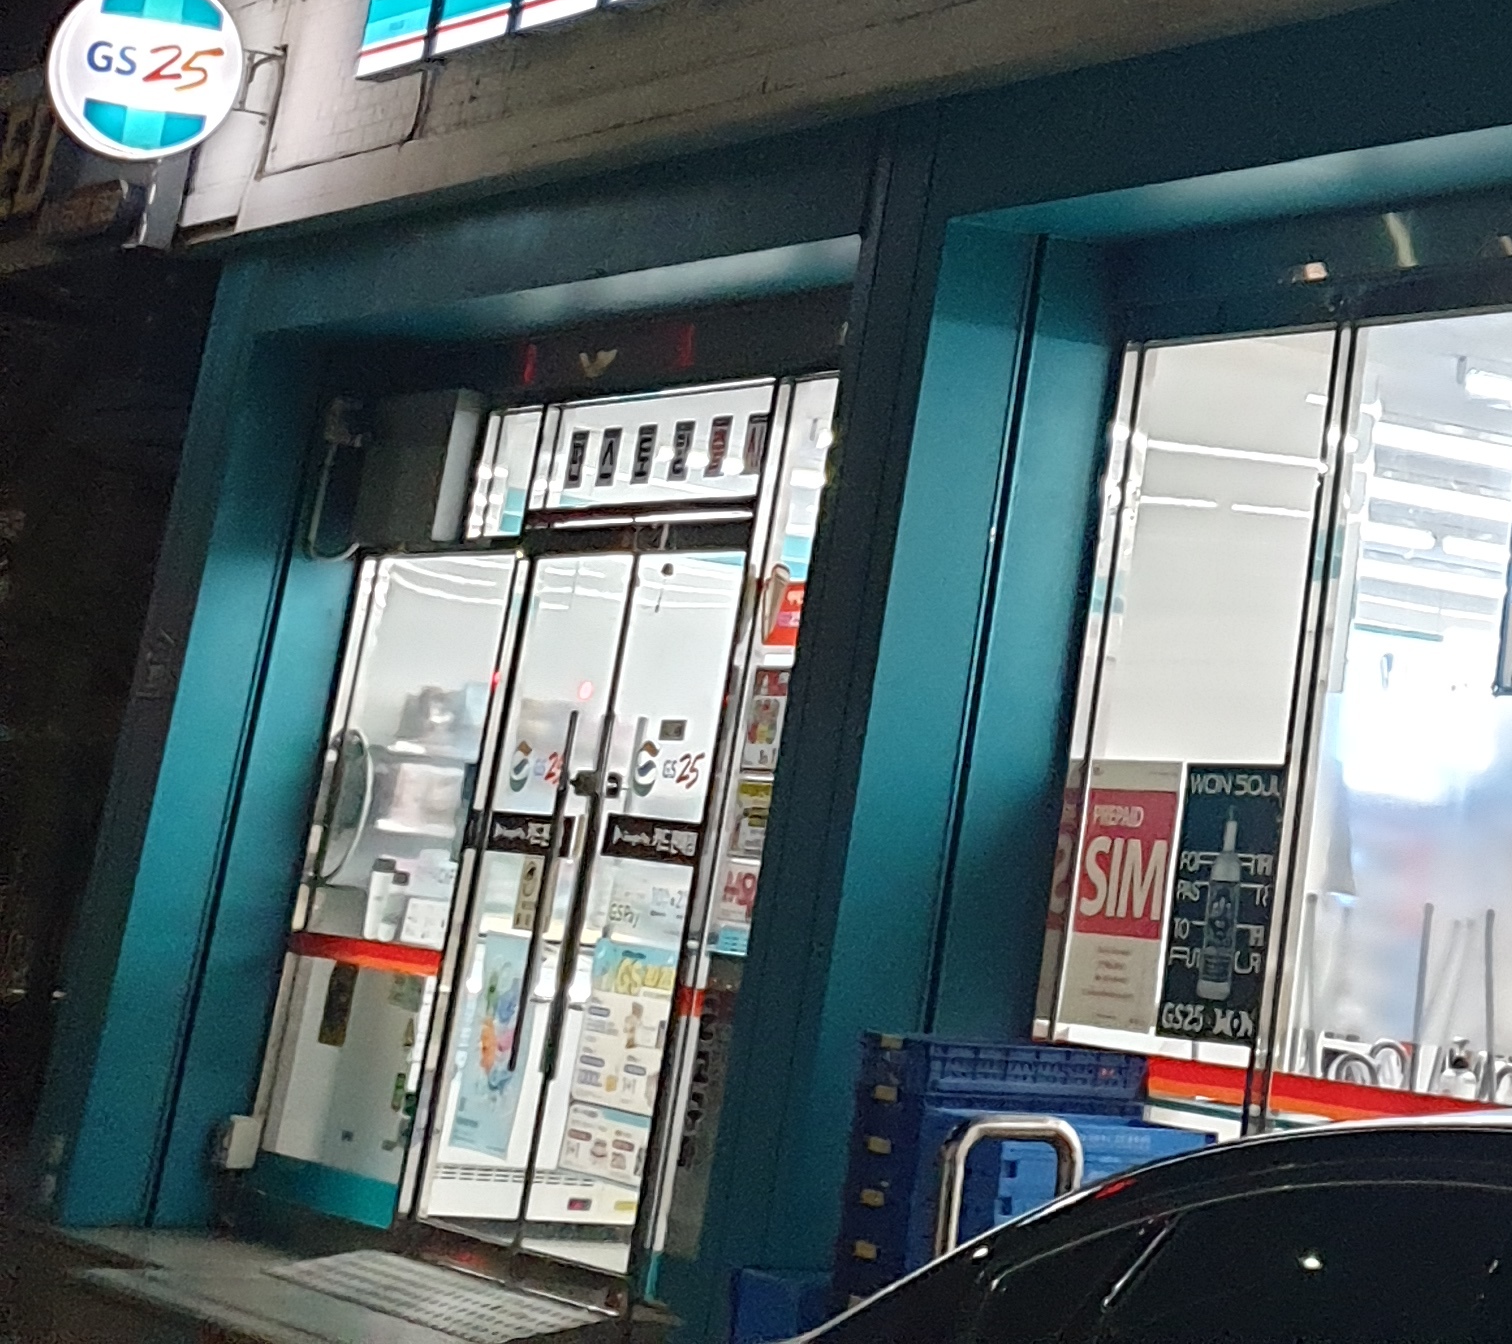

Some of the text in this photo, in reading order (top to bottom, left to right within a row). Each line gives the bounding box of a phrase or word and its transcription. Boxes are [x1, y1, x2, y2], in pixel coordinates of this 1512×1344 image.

[86, 39, 225, 92] GS25
[662, 752, 705, 790] GS25
[1079, 835, 1169, 921] SIM
[1161, 1002, 1204, 1033] GS25
